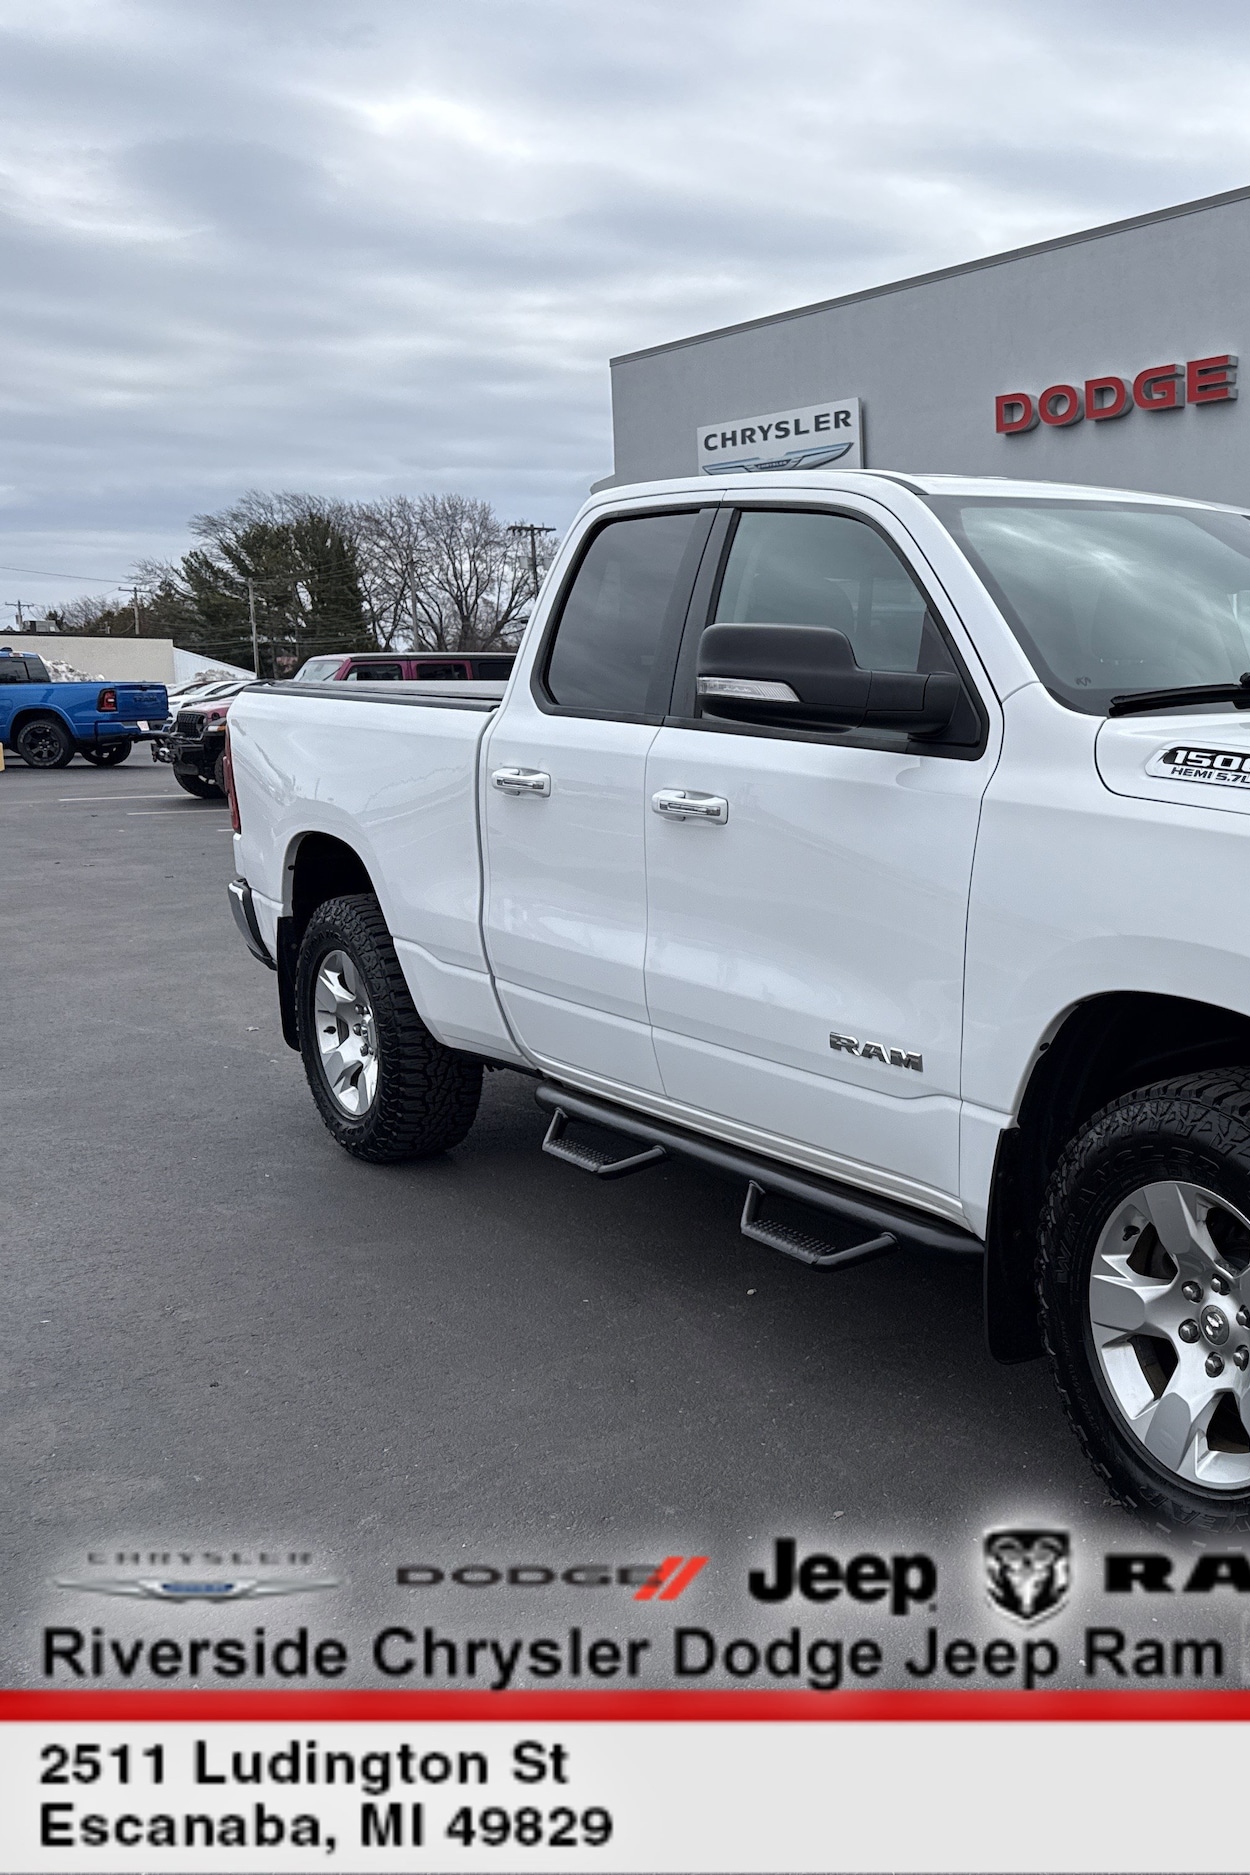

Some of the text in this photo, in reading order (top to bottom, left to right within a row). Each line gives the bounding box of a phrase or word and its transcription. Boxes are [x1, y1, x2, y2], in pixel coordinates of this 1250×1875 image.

[995, 354, 1238, 434] DODGE
[702, 408, 853, 452] CHRYSLER
[1171, 766, 1213, 779] HEMI
[829, 1031, 924, 1073] RAM
